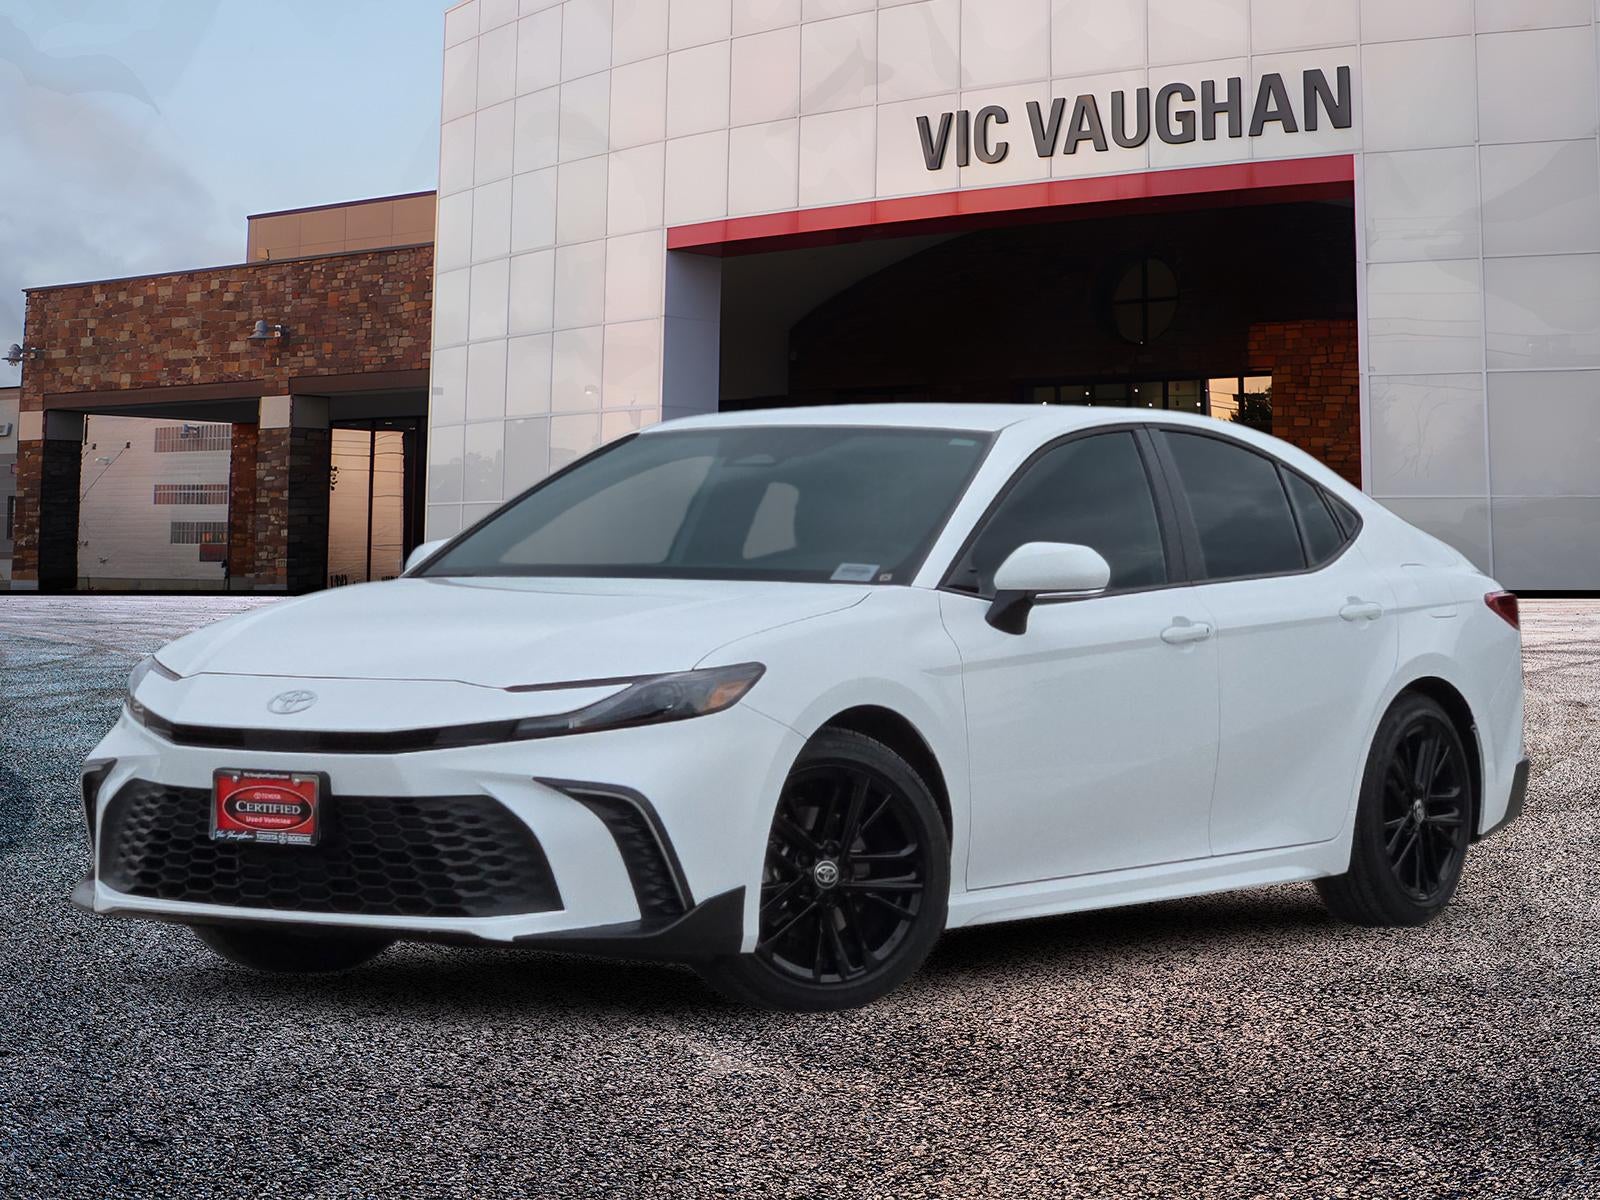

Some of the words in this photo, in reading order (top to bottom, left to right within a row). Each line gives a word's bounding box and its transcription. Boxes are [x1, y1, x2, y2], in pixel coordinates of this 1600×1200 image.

[916, 105, 1009, 170] VIC
[1026, 65, 1352, 157] VAUGHAN
[235, 800, 301, 815] CERTIFIED
[264, 817, 291, 825] Vehicles
